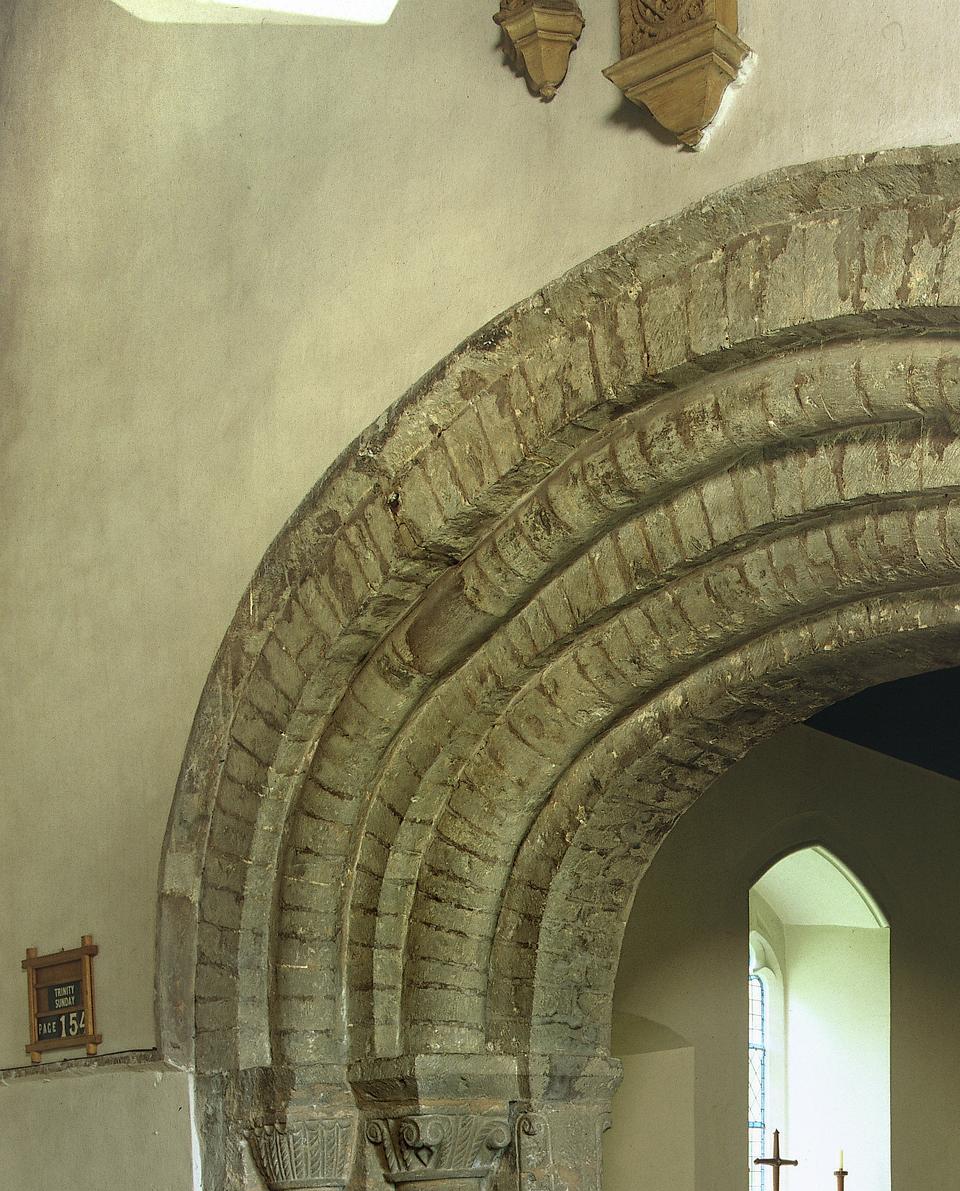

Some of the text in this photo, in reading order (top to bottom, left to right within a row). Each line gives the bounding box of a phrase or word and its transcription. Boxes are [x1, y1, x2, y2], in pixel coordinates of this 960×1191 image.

[54, 985, 74, 997] TRINITY
[55, 996, 75, 1008] SUNDAY
[39, 1022, 56, 1035] PAGE
